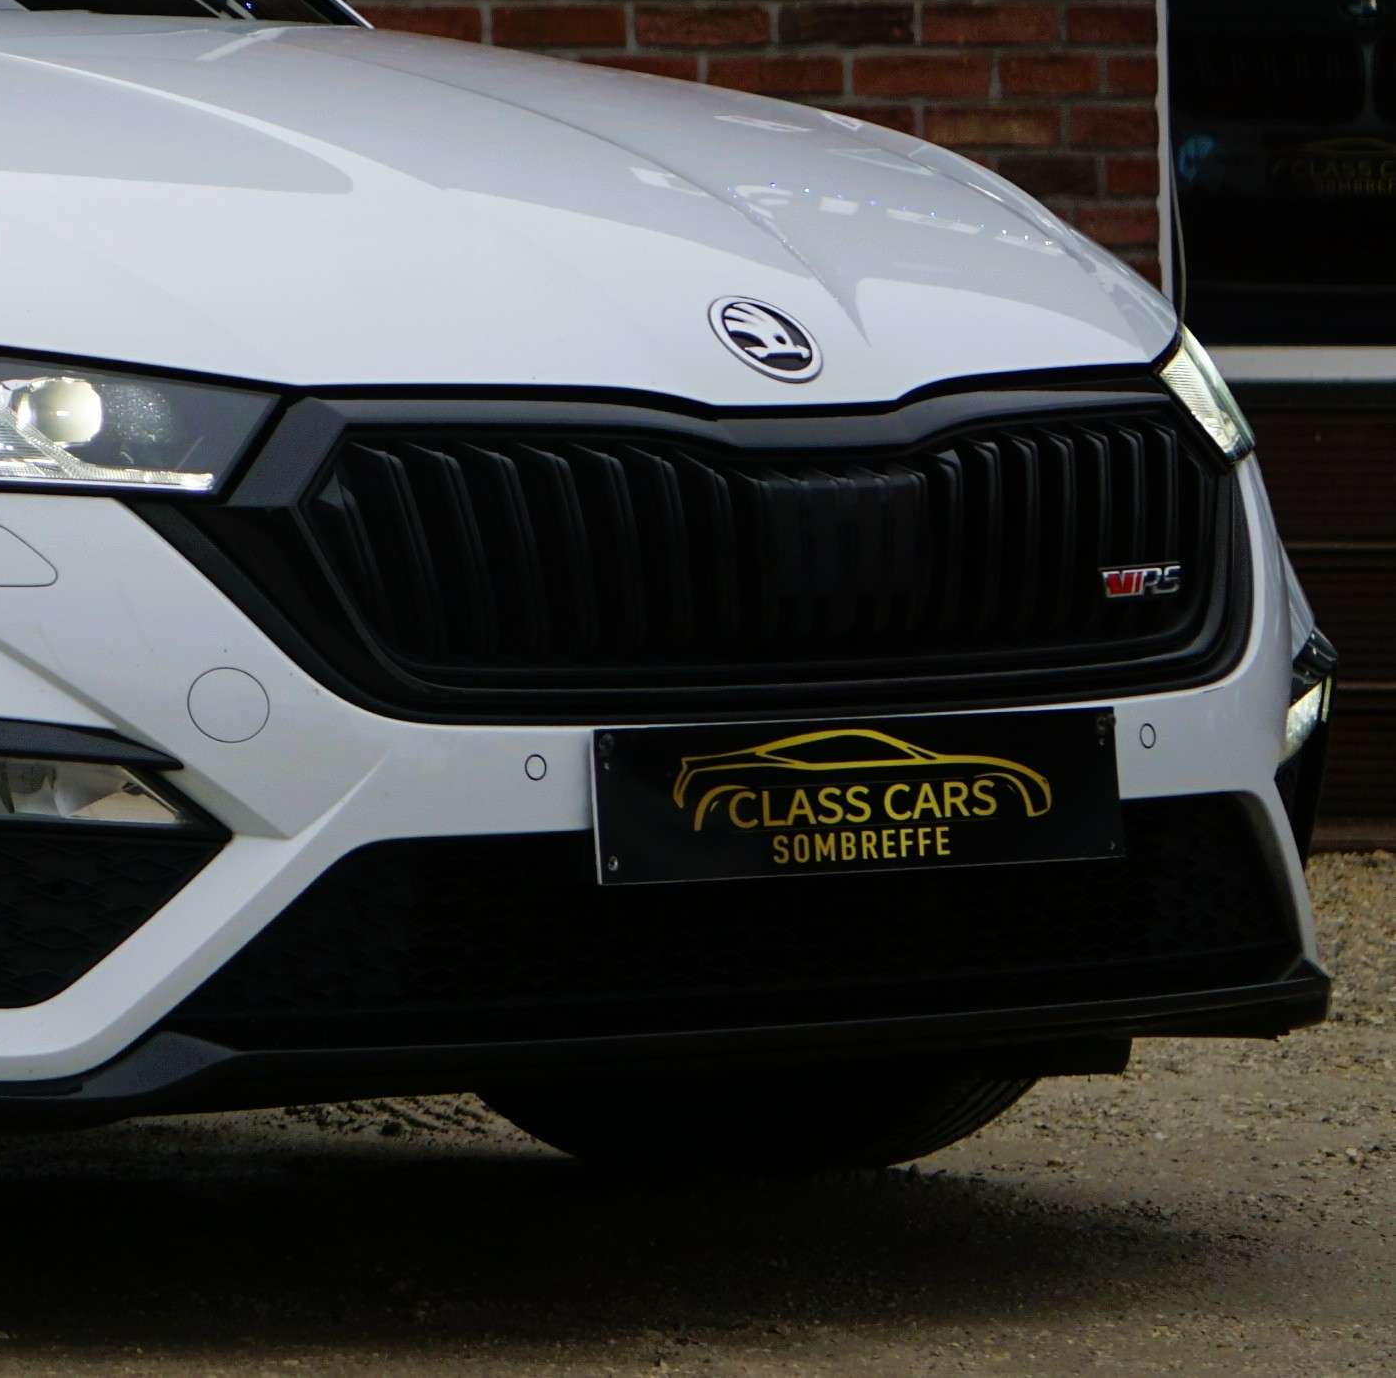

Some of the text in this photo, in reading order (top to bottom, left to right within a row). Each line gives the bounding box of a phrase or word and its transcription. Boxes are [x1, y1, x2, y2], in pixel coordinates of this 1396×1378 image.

[728, 779, 998, 829] CLASS CARS
[772, 826, 952, 864] SOMBREFFE
